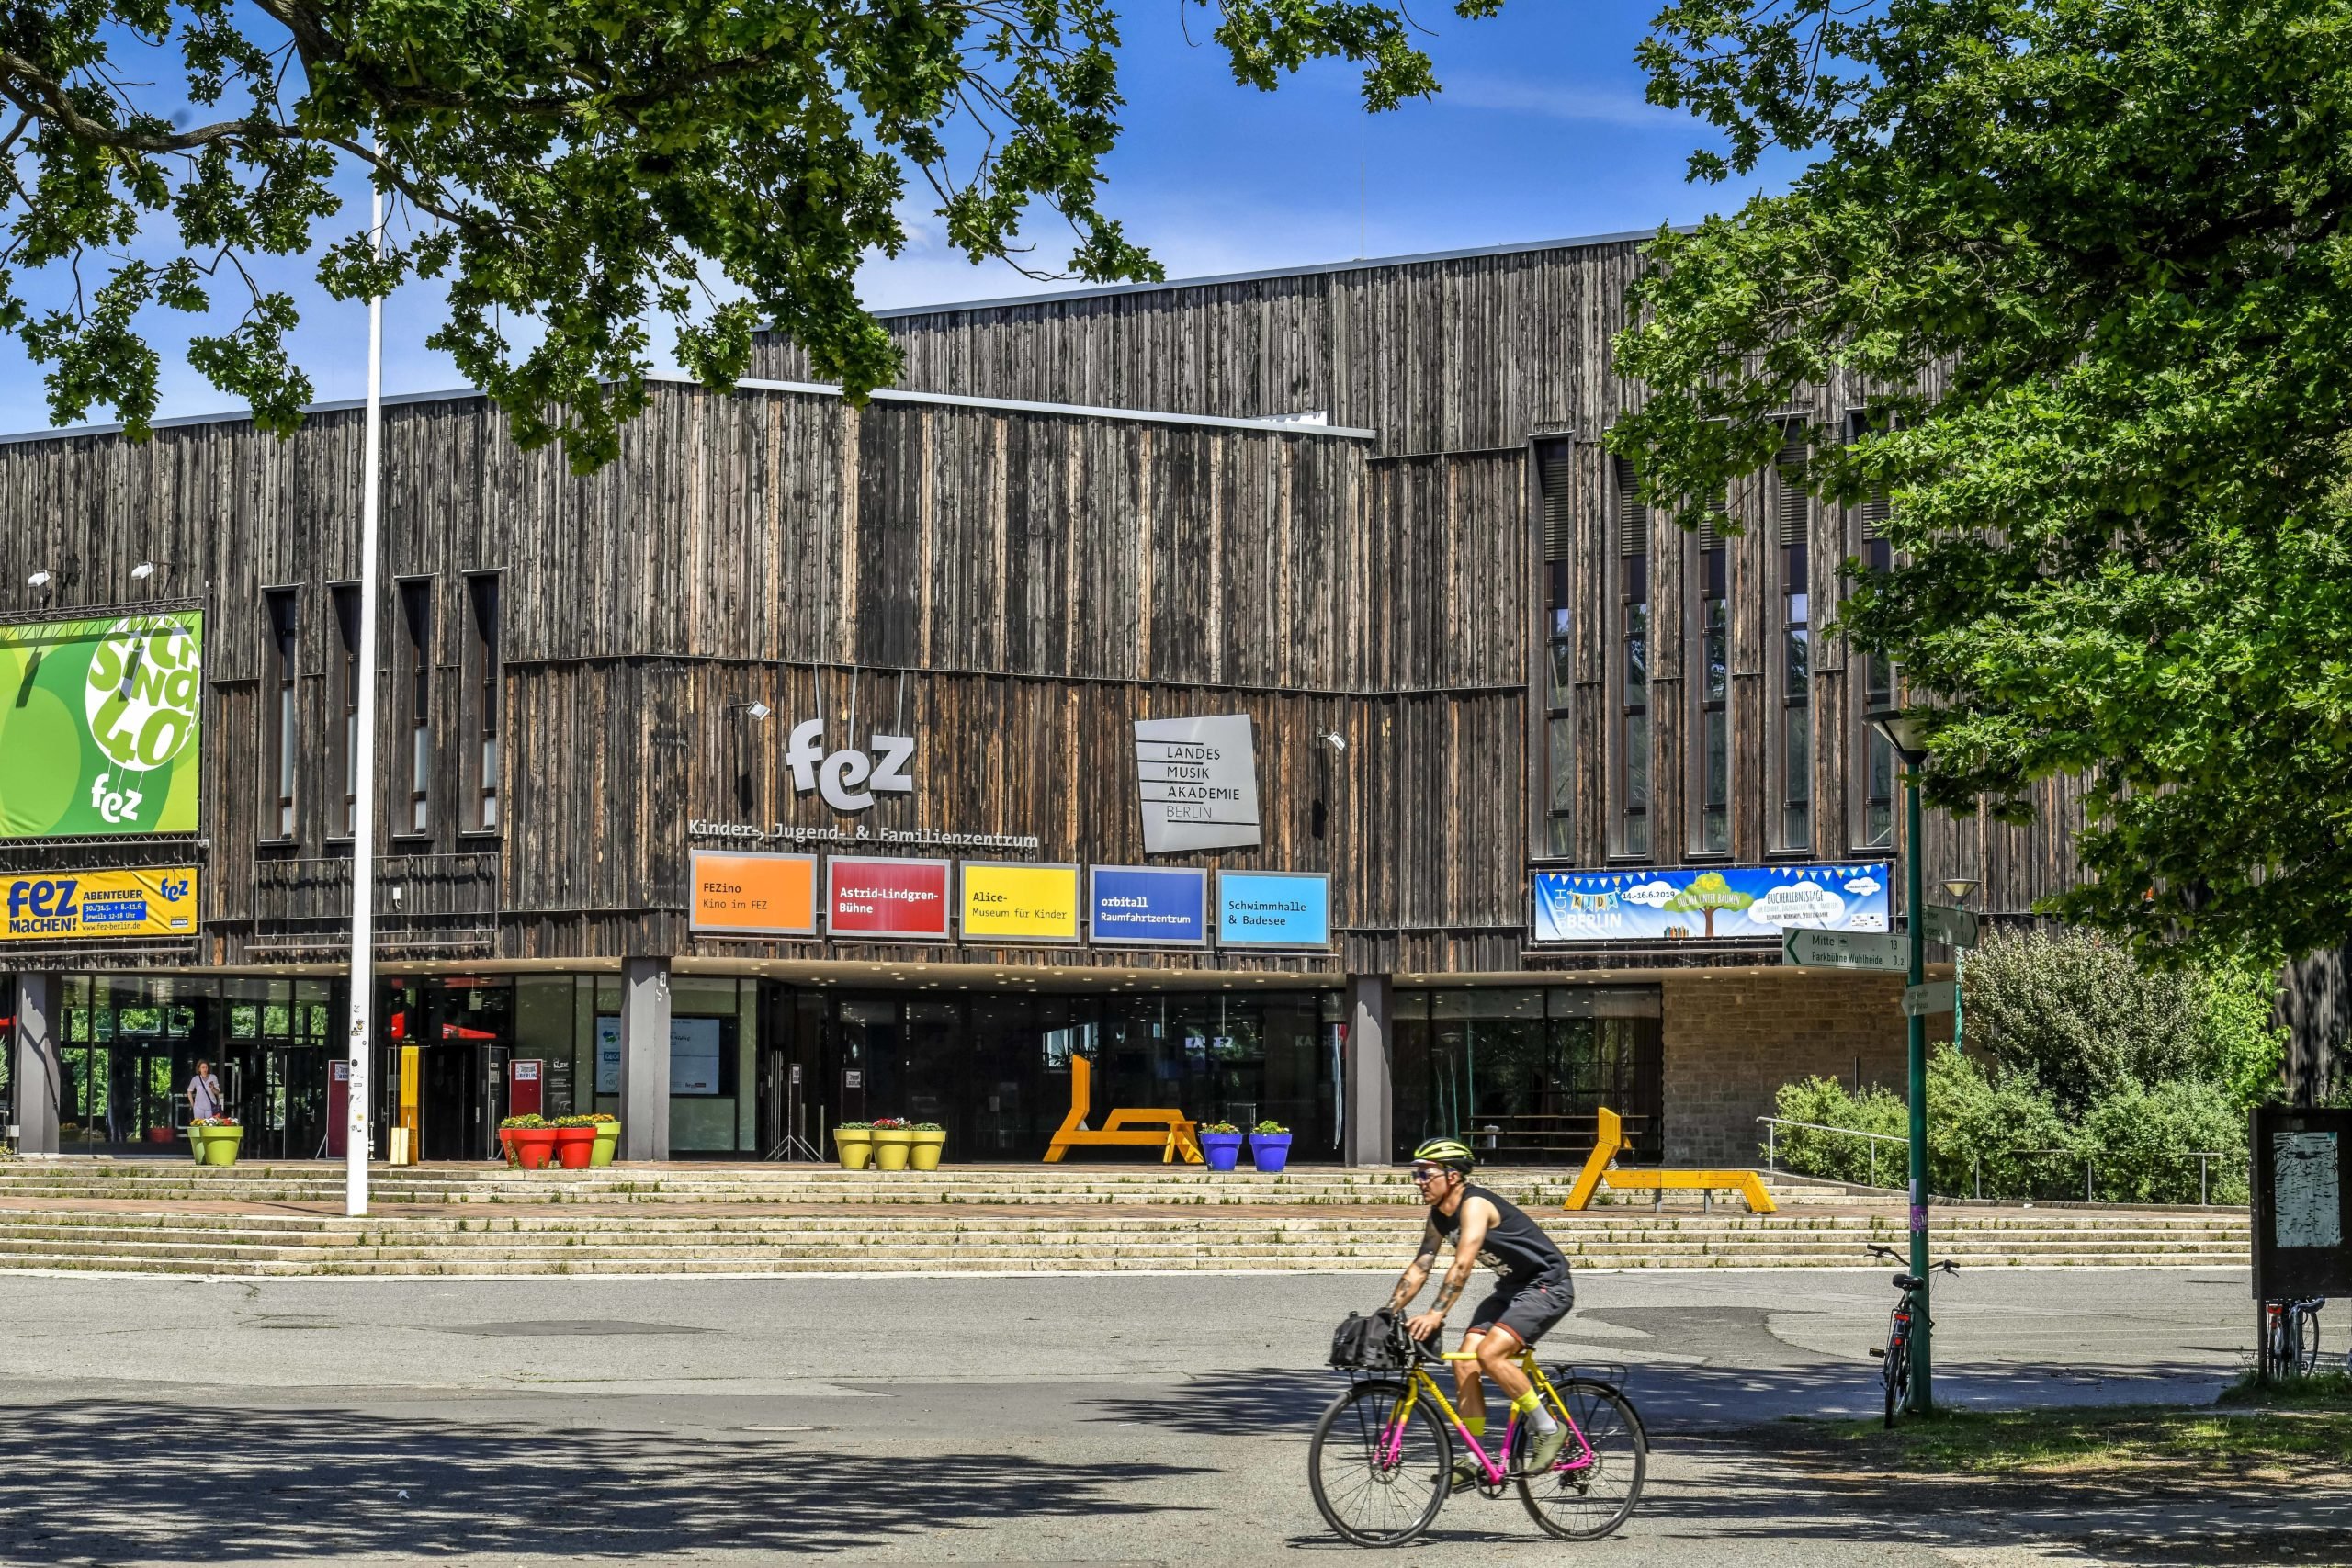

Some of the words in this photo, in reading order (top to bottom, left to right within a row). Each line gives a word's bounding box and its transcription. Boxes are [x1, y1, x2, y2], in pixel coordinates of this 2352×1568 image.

[1167, 746, 1221, 761] LANDES
[786, 718, 914, 810] fez
[1167, 766, 1210, 780] MUSIK
[91, 773, 143, 824] fez
[1167, 786, 1240, 800] AKADEMIE
[1166, 806, 1213, 818] BERLIN
[689, 819, 764, 840] Kinder-,
[775, 822, 846, 846] Jugend-
[855, 825, 870, 841] &
[879, 827, 1039, 848] Familienzentrum
[83, 889, 143, 901] ABENTEUER
[161, 878, 189, 902] fez
[703, 883, 741, 894] FEZino
[840, 887, 939, 903] Astrid-Lindgren-
[1623, 890, 1675, 900] 14.-16.6.2019
[7, 880, 78, 919] fez
[972, 892, 1008, 903] Alice-
[1101, 897, 1148, 908] orbitall
[1573, 894, 1614, 908] KIDS
[702, 899, 727, 910] Kino
[731, 899, 746, 909] im
[751, 900, 768, 910] FEZ
[839, 901, 873, 914] Bühne
[1227, 900, 1306, 913] Schwimmhalle
[85, 913, 107, 921] jeweils
[972, 908, 1010, 918] Museum
[1013, 908, 1030, 919] für
[1034, 908, 1068, 919] Kinder
[1101, 911, 1191, 924] Raumfahrtzentrum
[1228, 914, 1237, 924] &
[1243, 915, 1286, 926] Badesee
[83, 921, 141, 931] www.fez-berlin.de
[1567, 912, 1622, 929] BERLIN
[1812, 934, 1835, 947] Mitte
[1890, 939, 1898, 950] 13
[1811, 951, 1848, 964] Parkbühne
[1849, 953, 1883, 965] Wuhlheide
